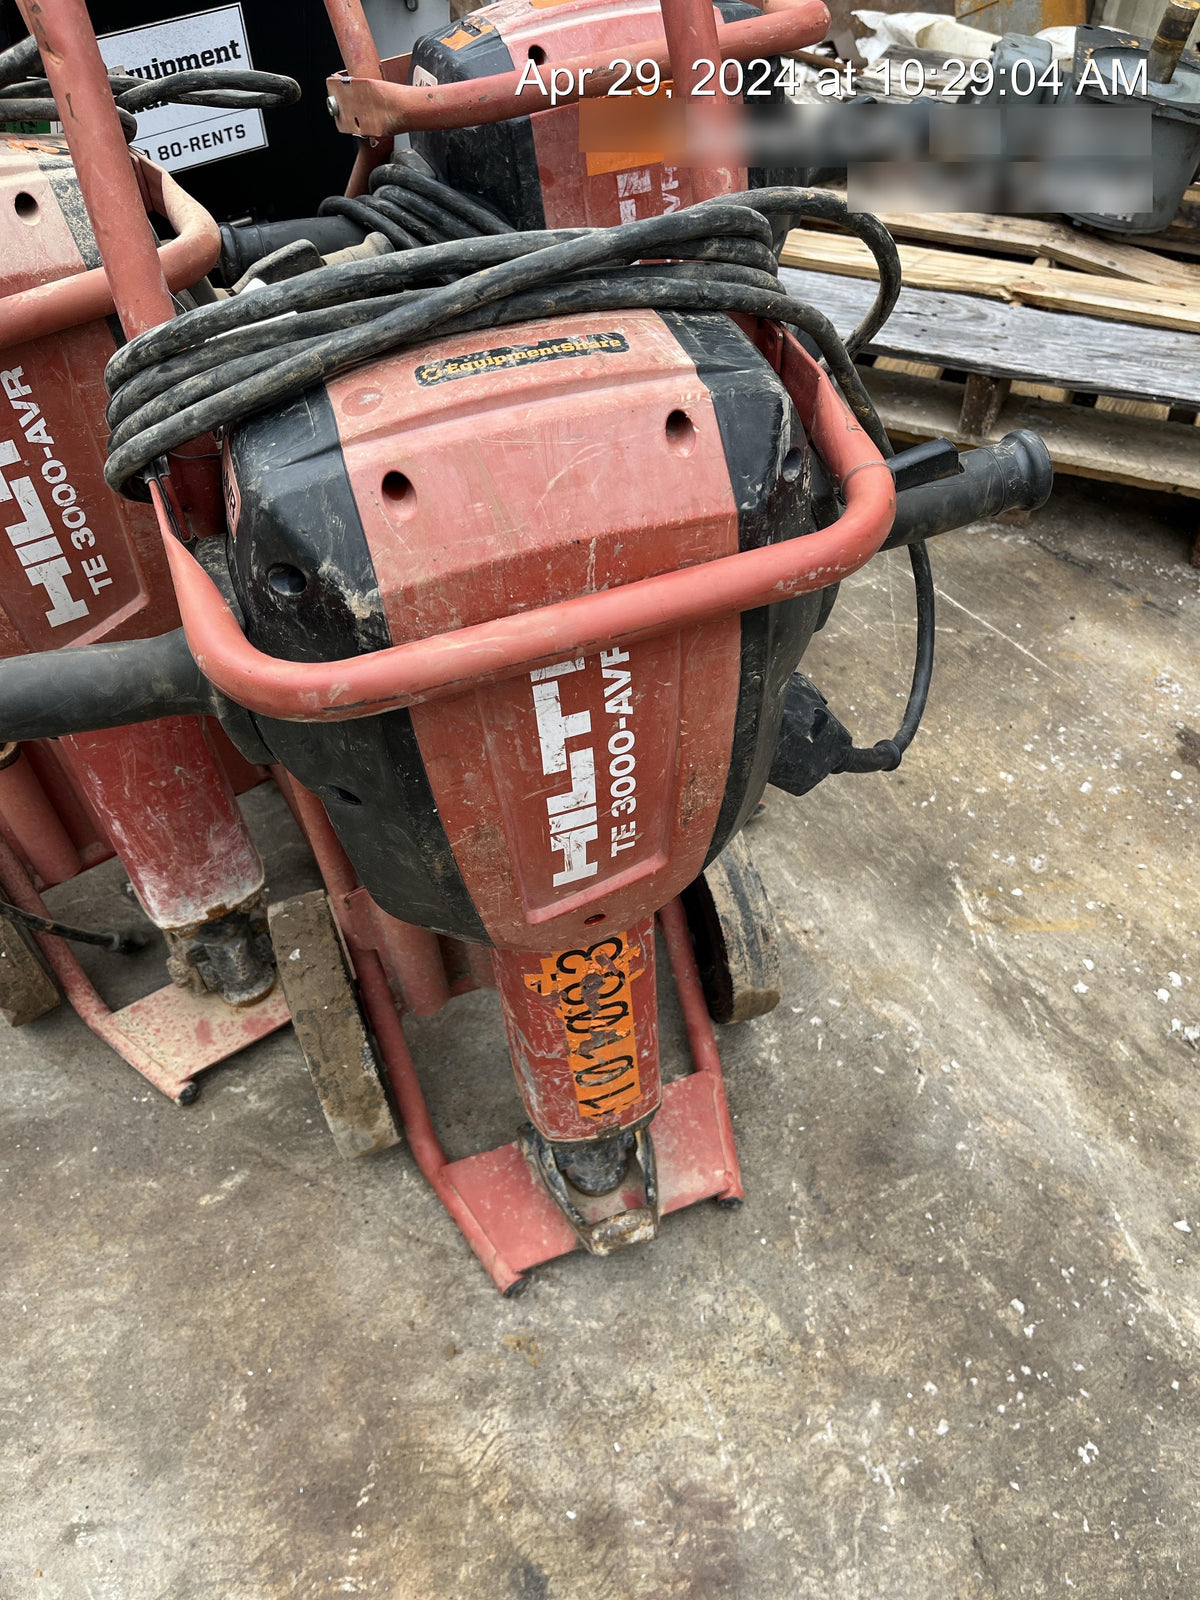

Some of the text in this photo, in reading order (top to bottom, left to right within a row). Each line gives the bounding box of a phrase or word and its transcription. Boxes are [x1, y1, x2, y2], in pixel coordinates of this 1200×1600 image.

[126, 40, 242, 81] uipment
[158, 124, 246, 161] 80-RENTS
[445, 337, 622, 375] EquipmentShare
[0, 365, 113, 596] TE 3000-AVR
[611, 821, 636, 858] TE
